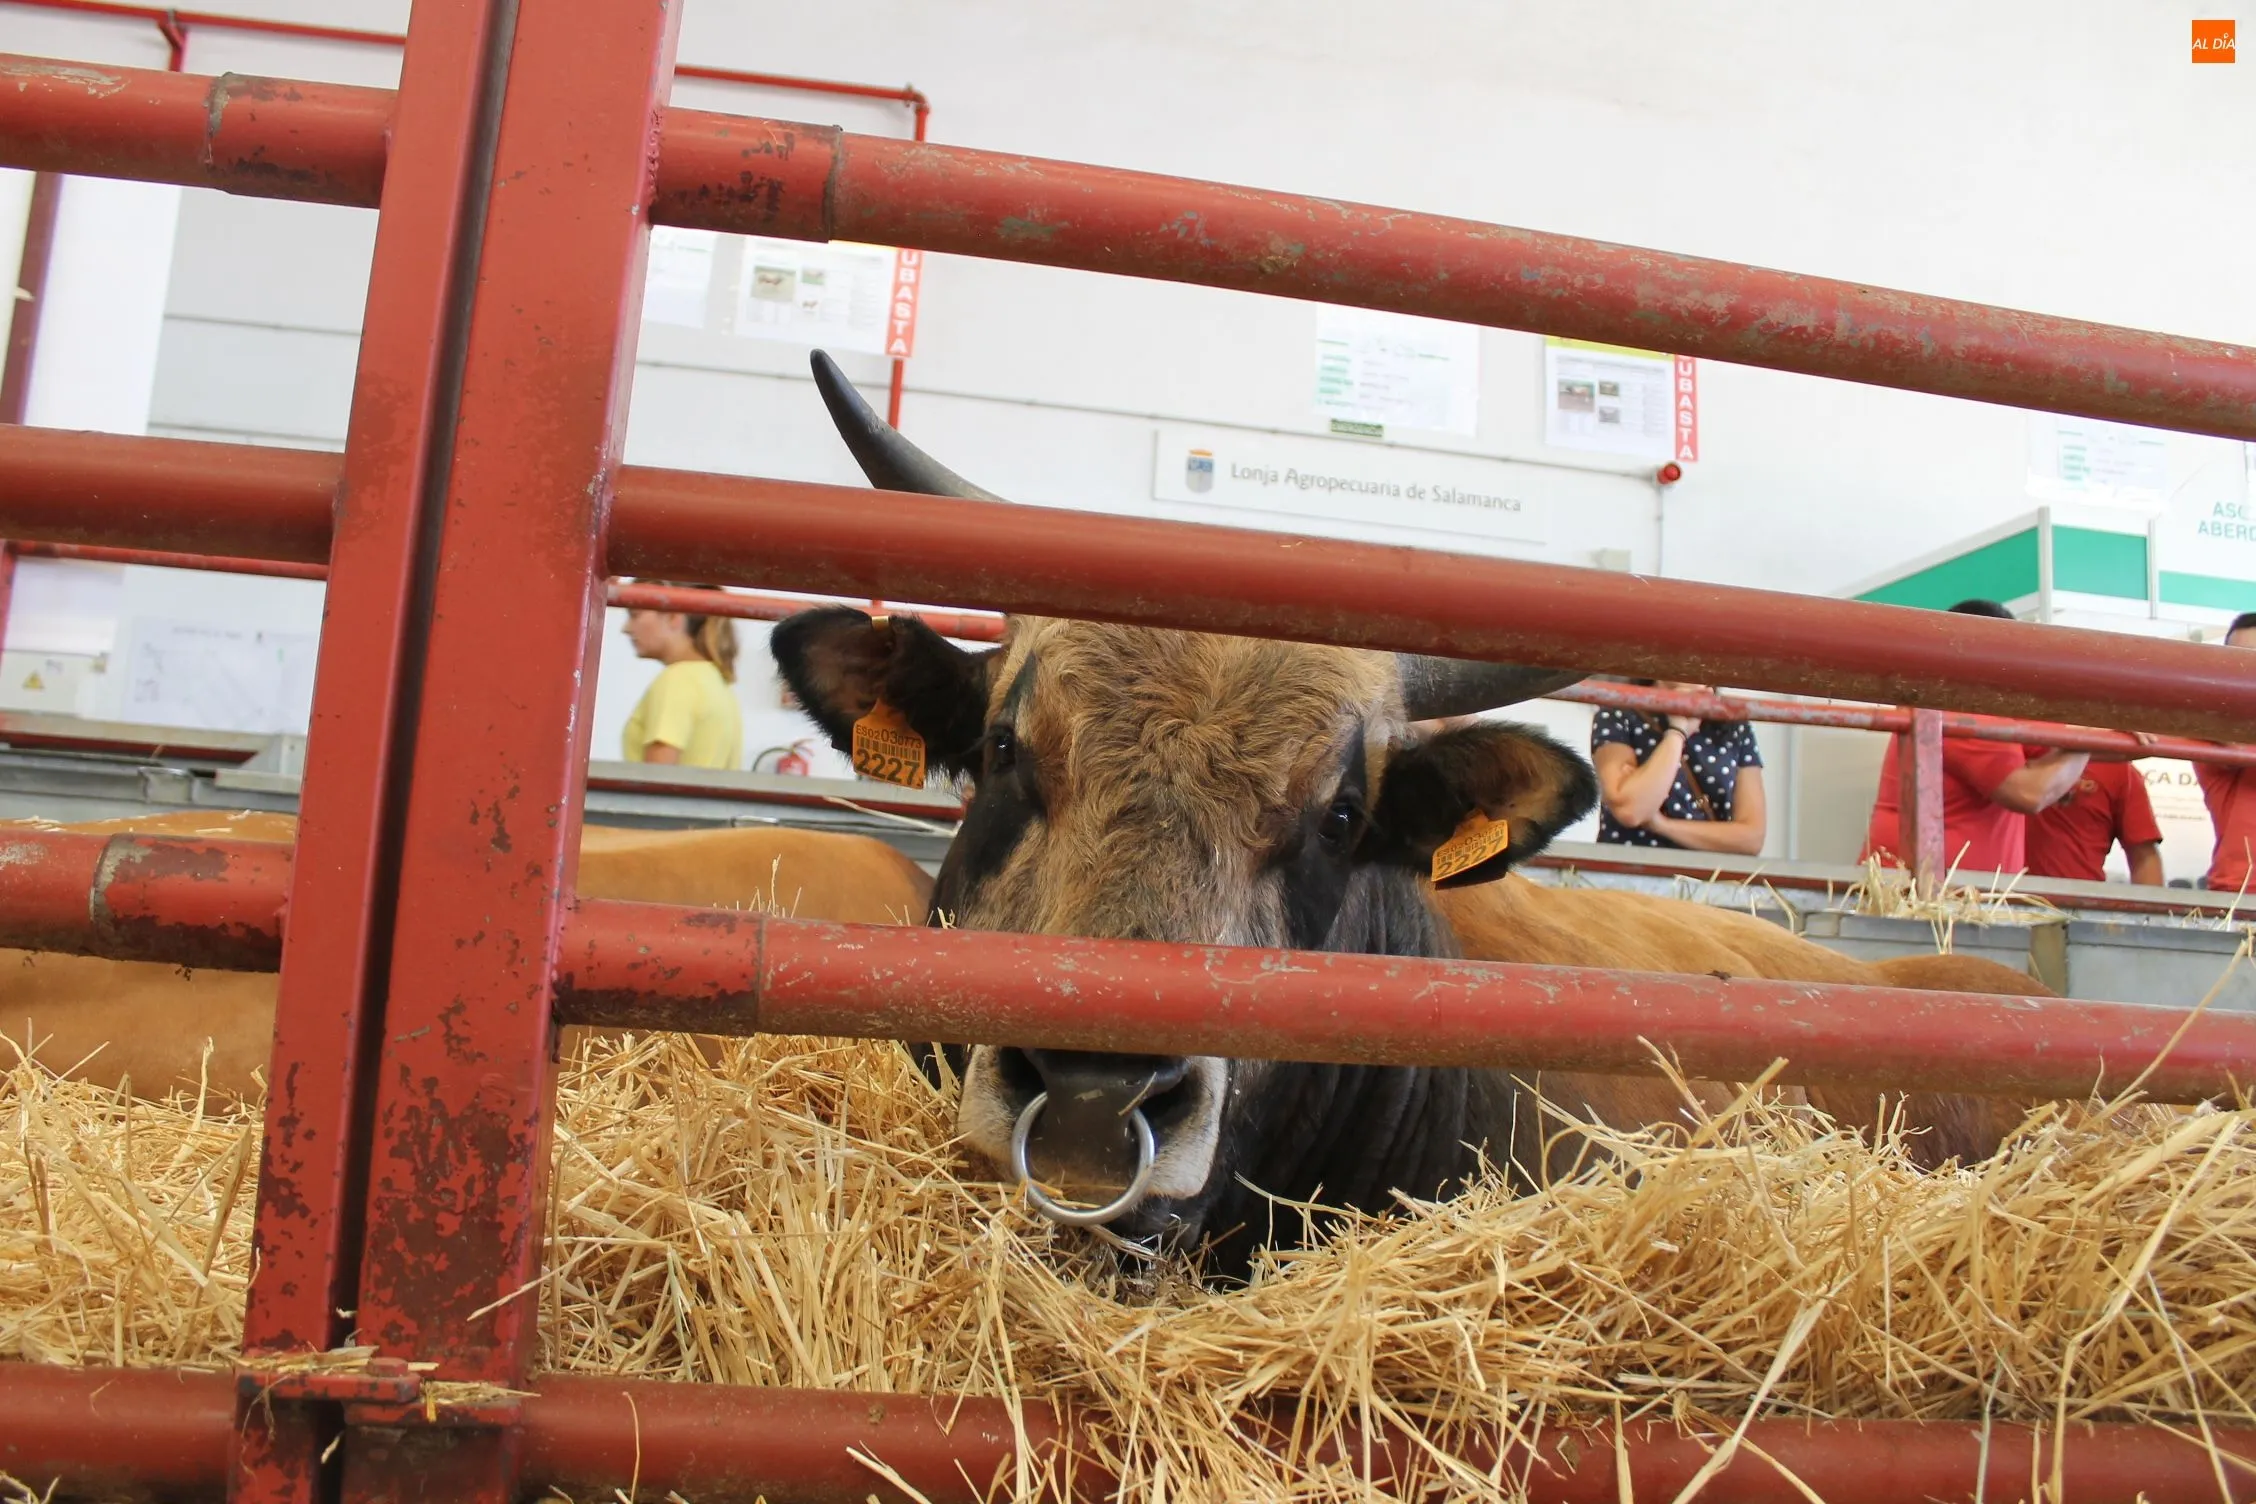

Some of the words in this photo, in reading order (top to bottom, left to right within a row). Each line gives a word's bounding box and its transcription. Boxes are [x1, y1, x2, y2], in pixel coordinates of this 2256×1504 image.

[1677, 354, 1695, 460] UBASTA
[1231, 462, 1279, 487] Lonja
[1284, 467, 1400, 497] Agropecuaria
[1406, 483, 1426, 500] de
[1432, 484, 1521, 512] Salamanca
[856, 748, 921, 785] 2227
